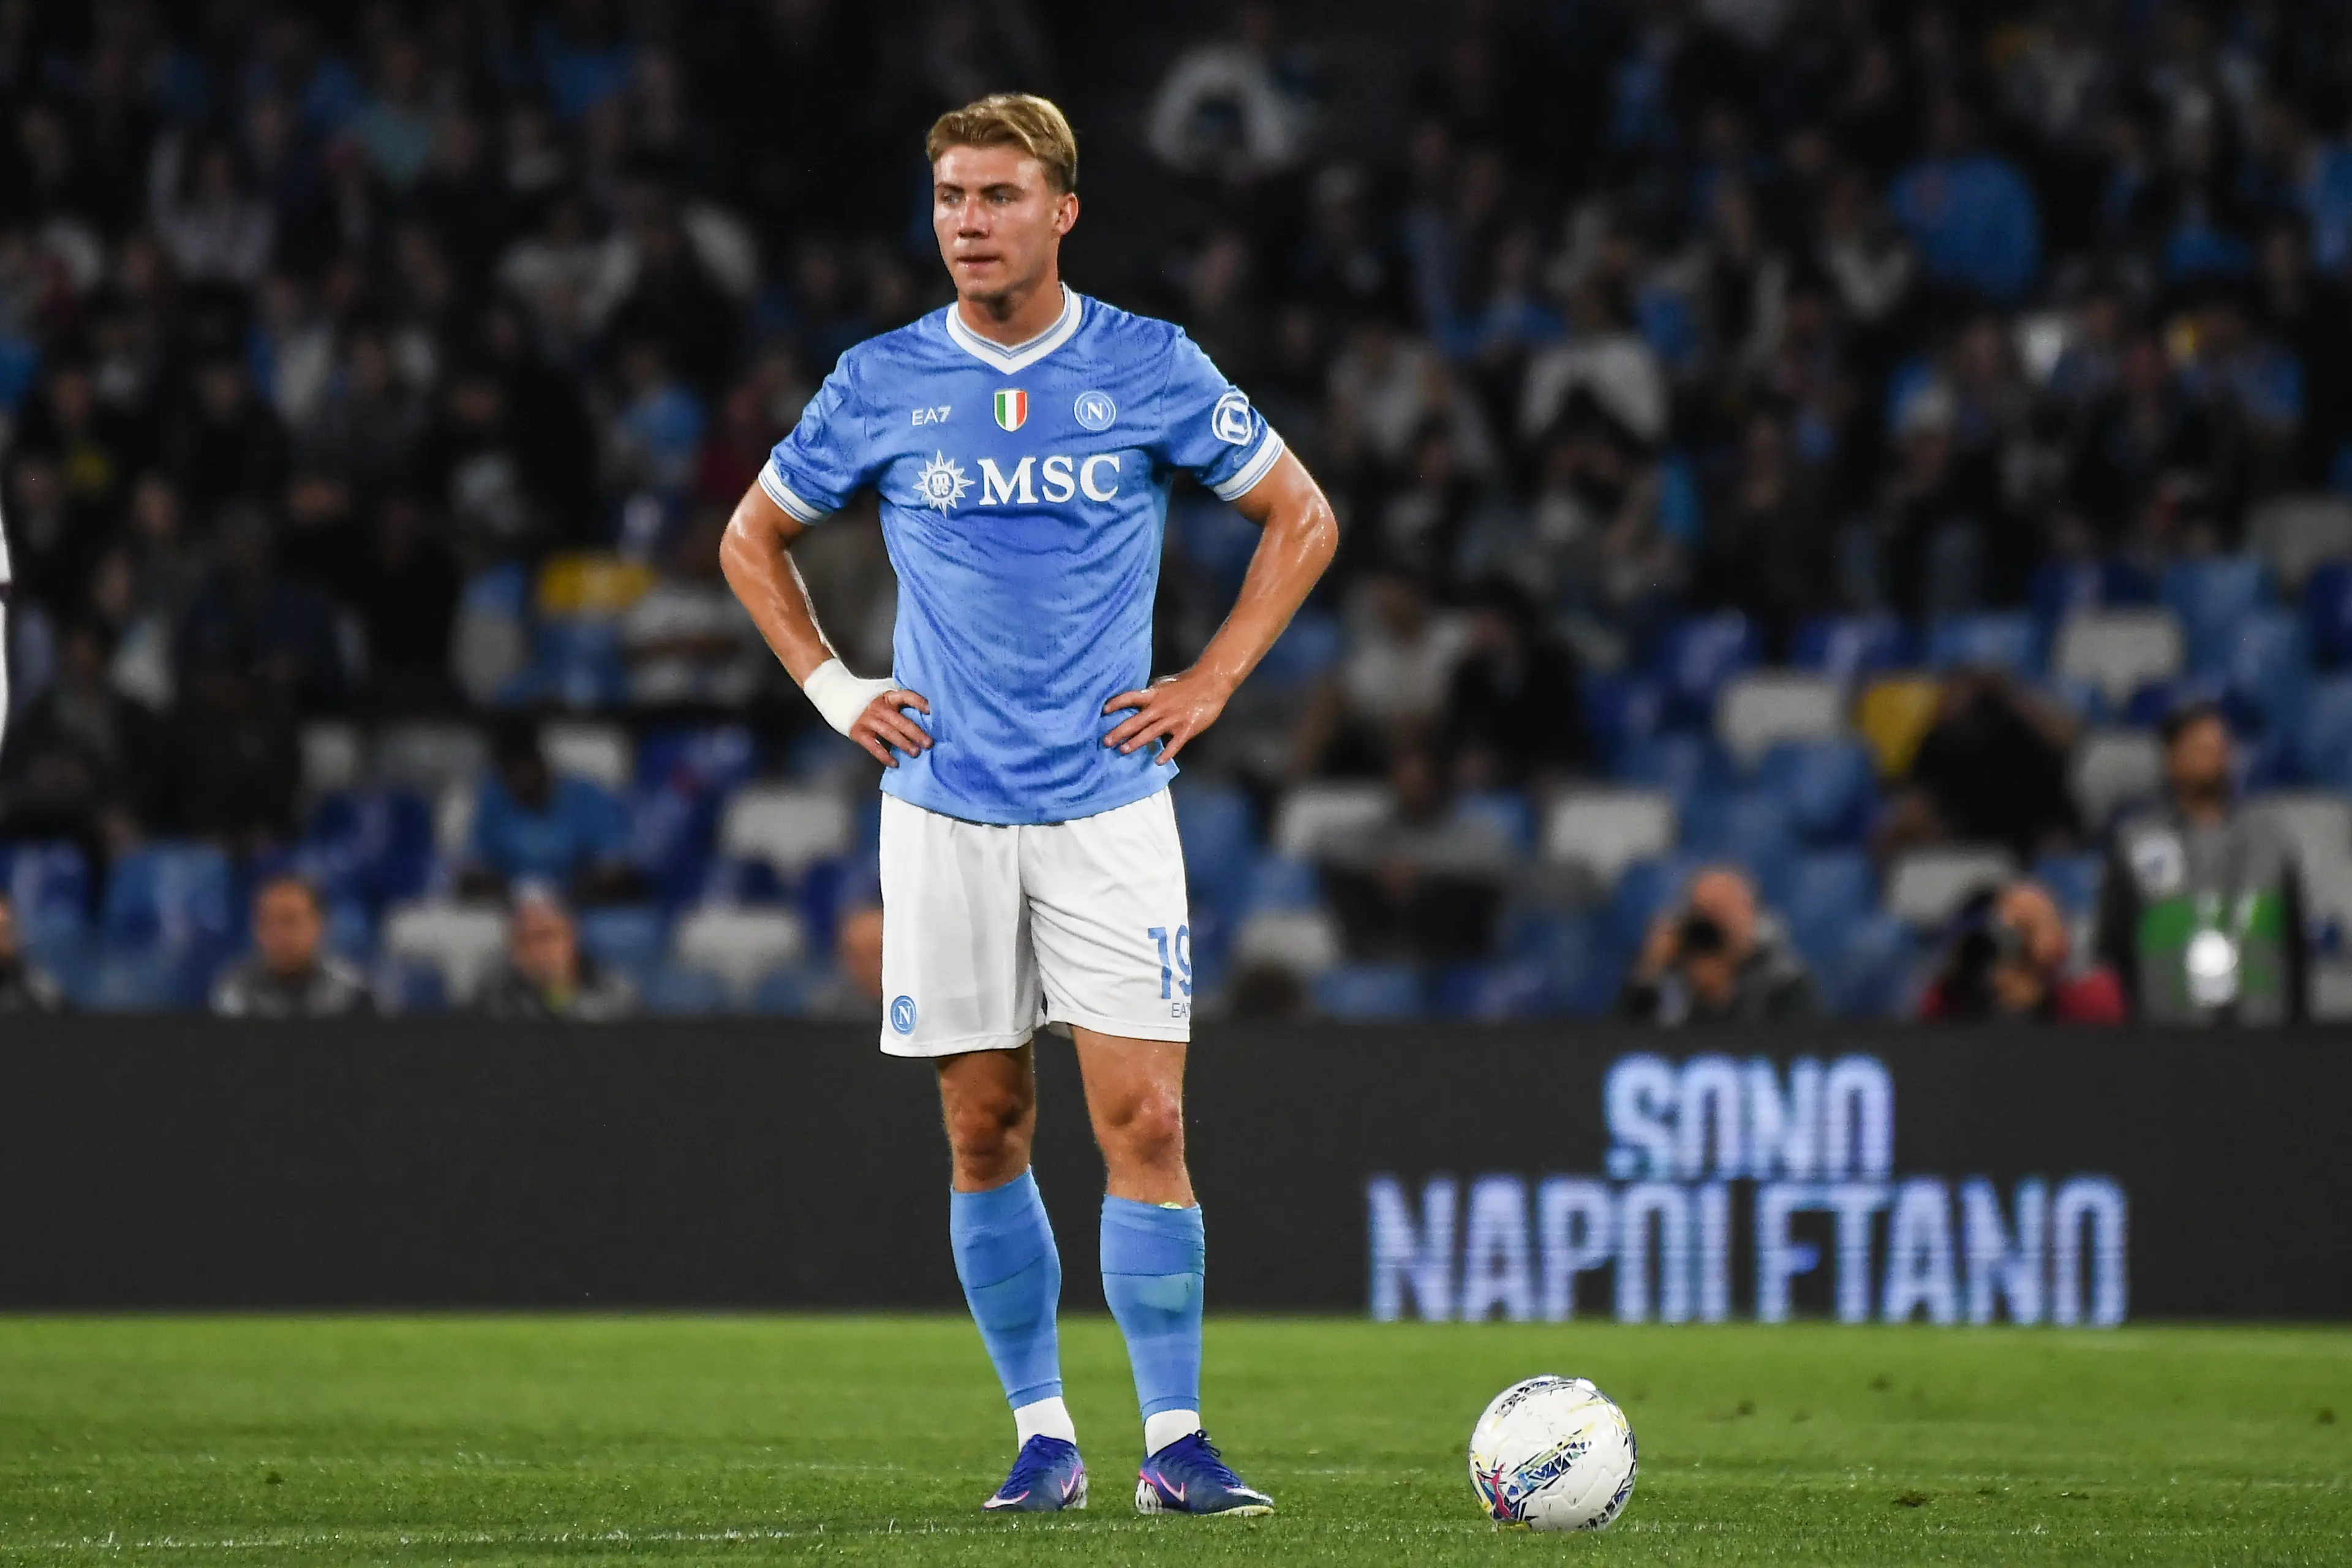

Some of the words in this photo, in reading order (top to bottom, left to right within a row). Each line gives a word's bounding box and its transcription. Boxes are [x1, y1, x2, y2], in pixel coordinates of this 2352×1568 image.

[911, 405, 951, 426] EA7
[1087, 402, 1102, 420] N
[977, 454, 1120, 506] MSC
[1147, 924, 1191, 1000] 19
[897, 1005, 911, 1025] N
[1604, 1052, 1894, 1178] SONO
